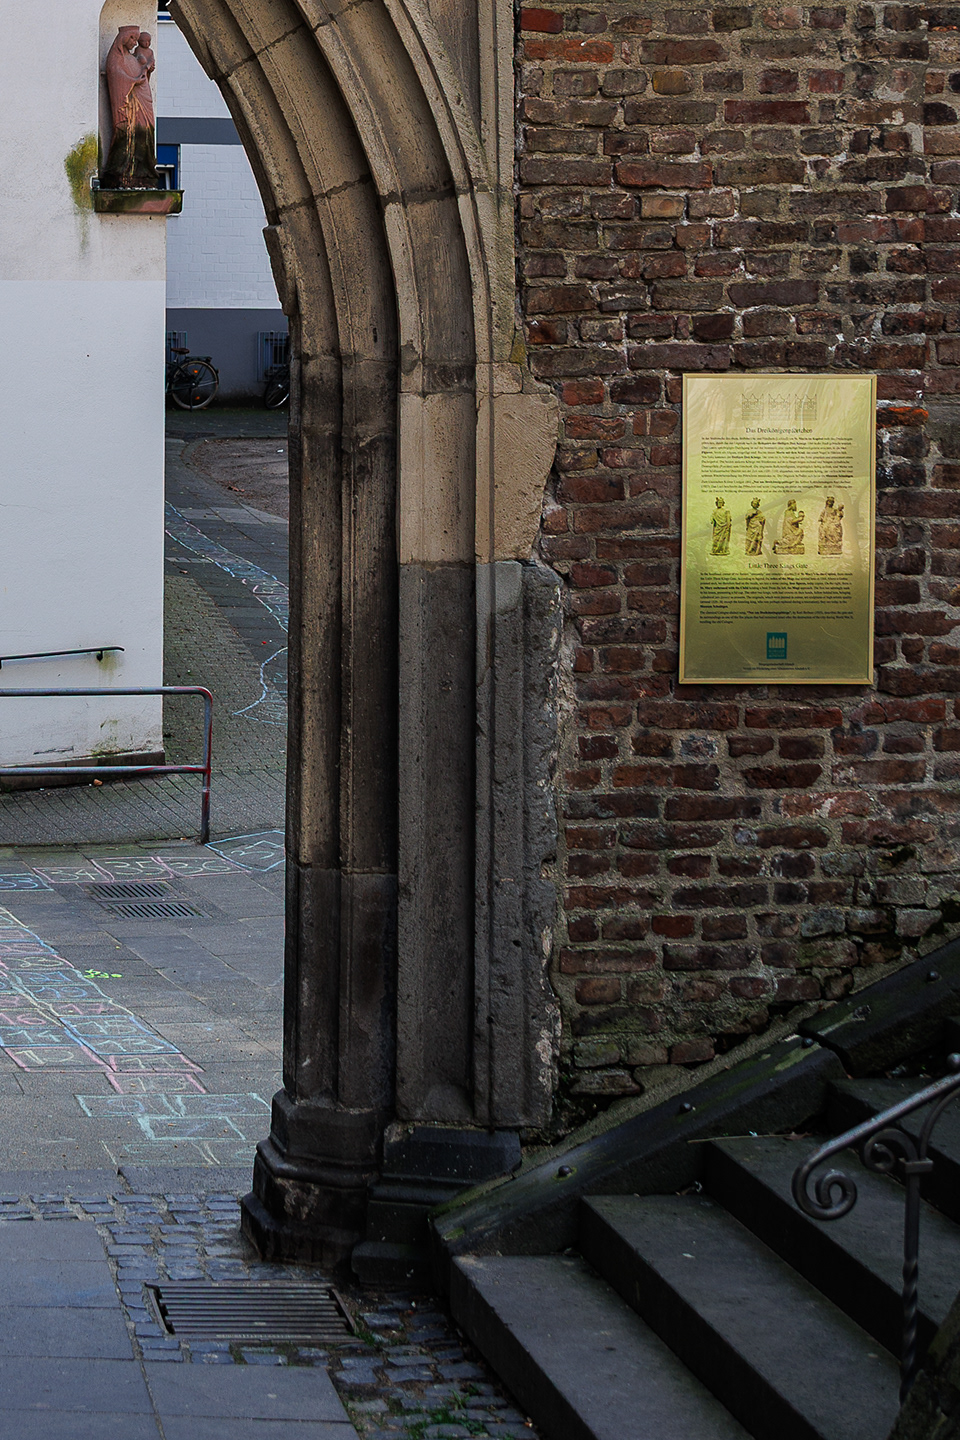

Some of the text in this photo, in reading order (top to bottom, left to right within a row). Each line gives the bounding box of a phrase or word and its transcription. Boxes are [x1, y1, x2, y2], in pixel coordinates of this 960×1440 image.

[42, 868, 96, 881] 34
[104, 861, 165, 875] 35
[174, 861, 231, 875] 36
[73, 1019, 137, 1034] 15
[7, 1030, 61, 1043] 14
[96, 1038, 164, 1052] 13
